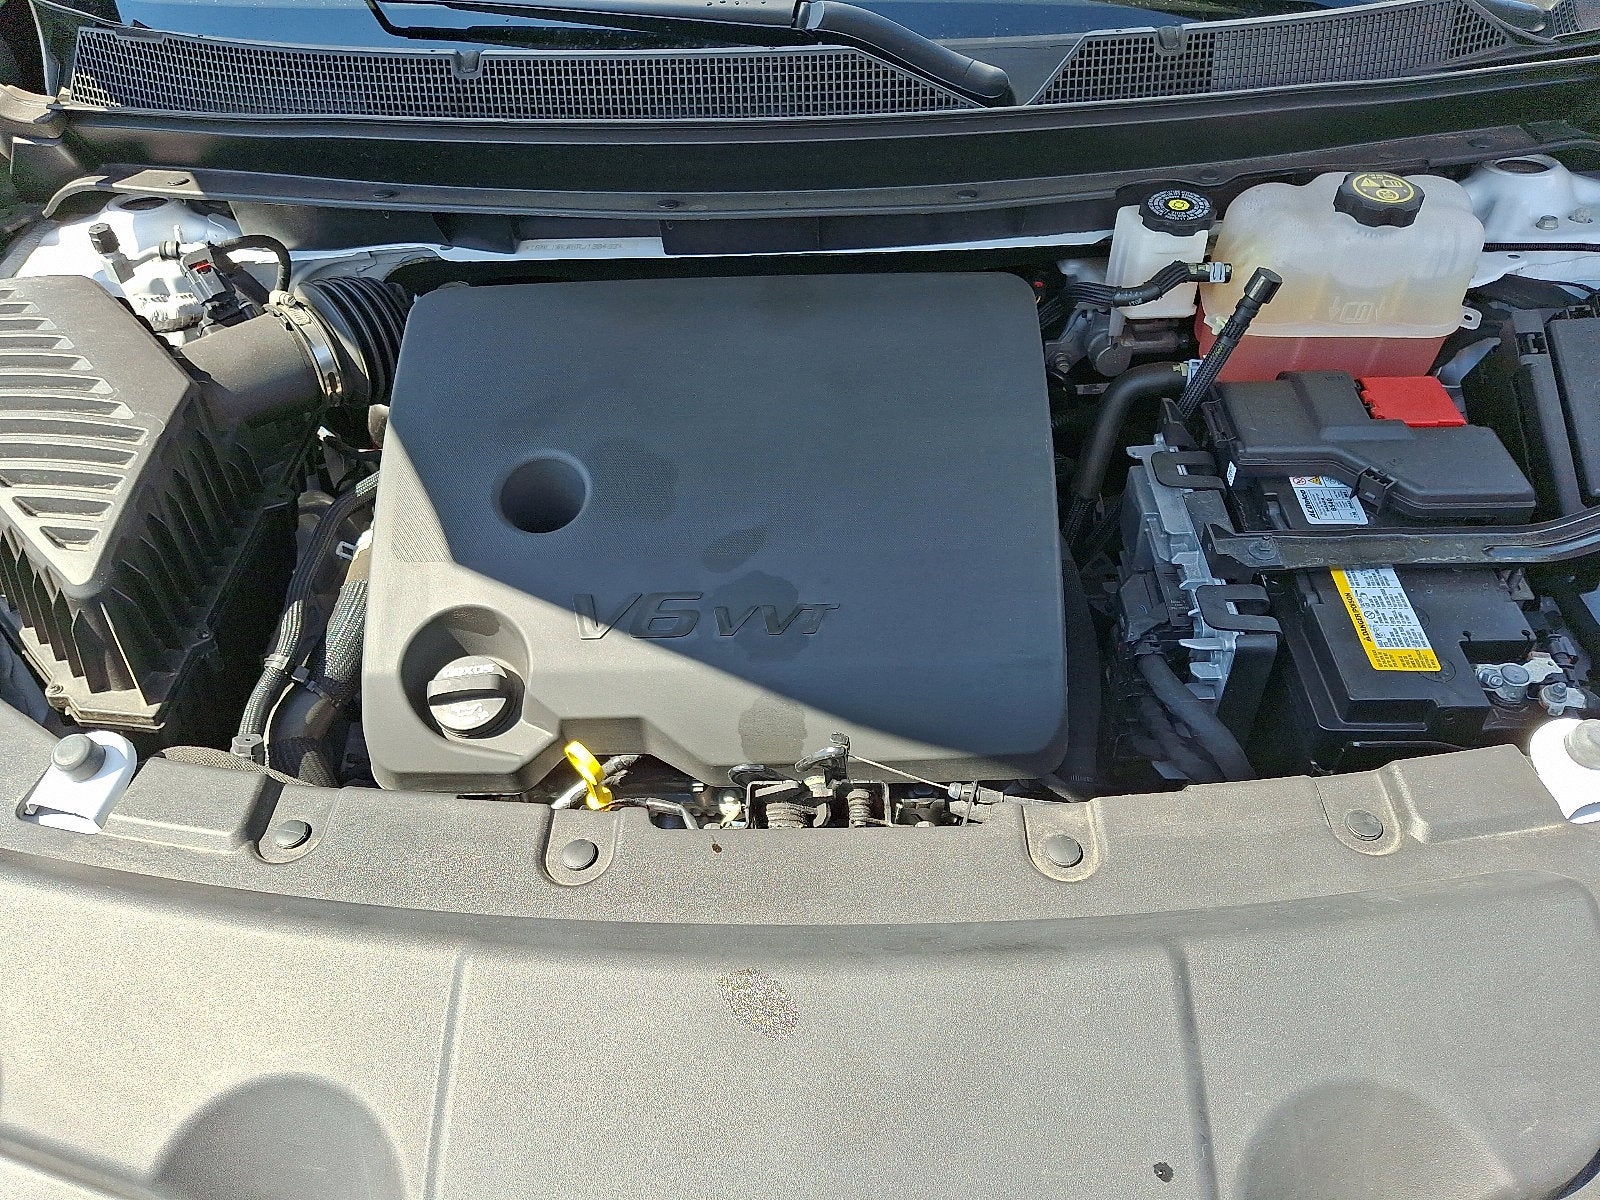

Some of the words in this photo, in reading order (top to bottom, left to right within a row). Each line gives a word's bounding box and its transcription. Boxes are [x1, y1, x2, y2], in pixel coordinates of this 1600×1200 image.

[1344, 592, 1358, 614] POISON
[572, 591, 704, 640] V6
[713, 602, 841, 637] VVT
[1354, 613, 1369, 637] DANGER
